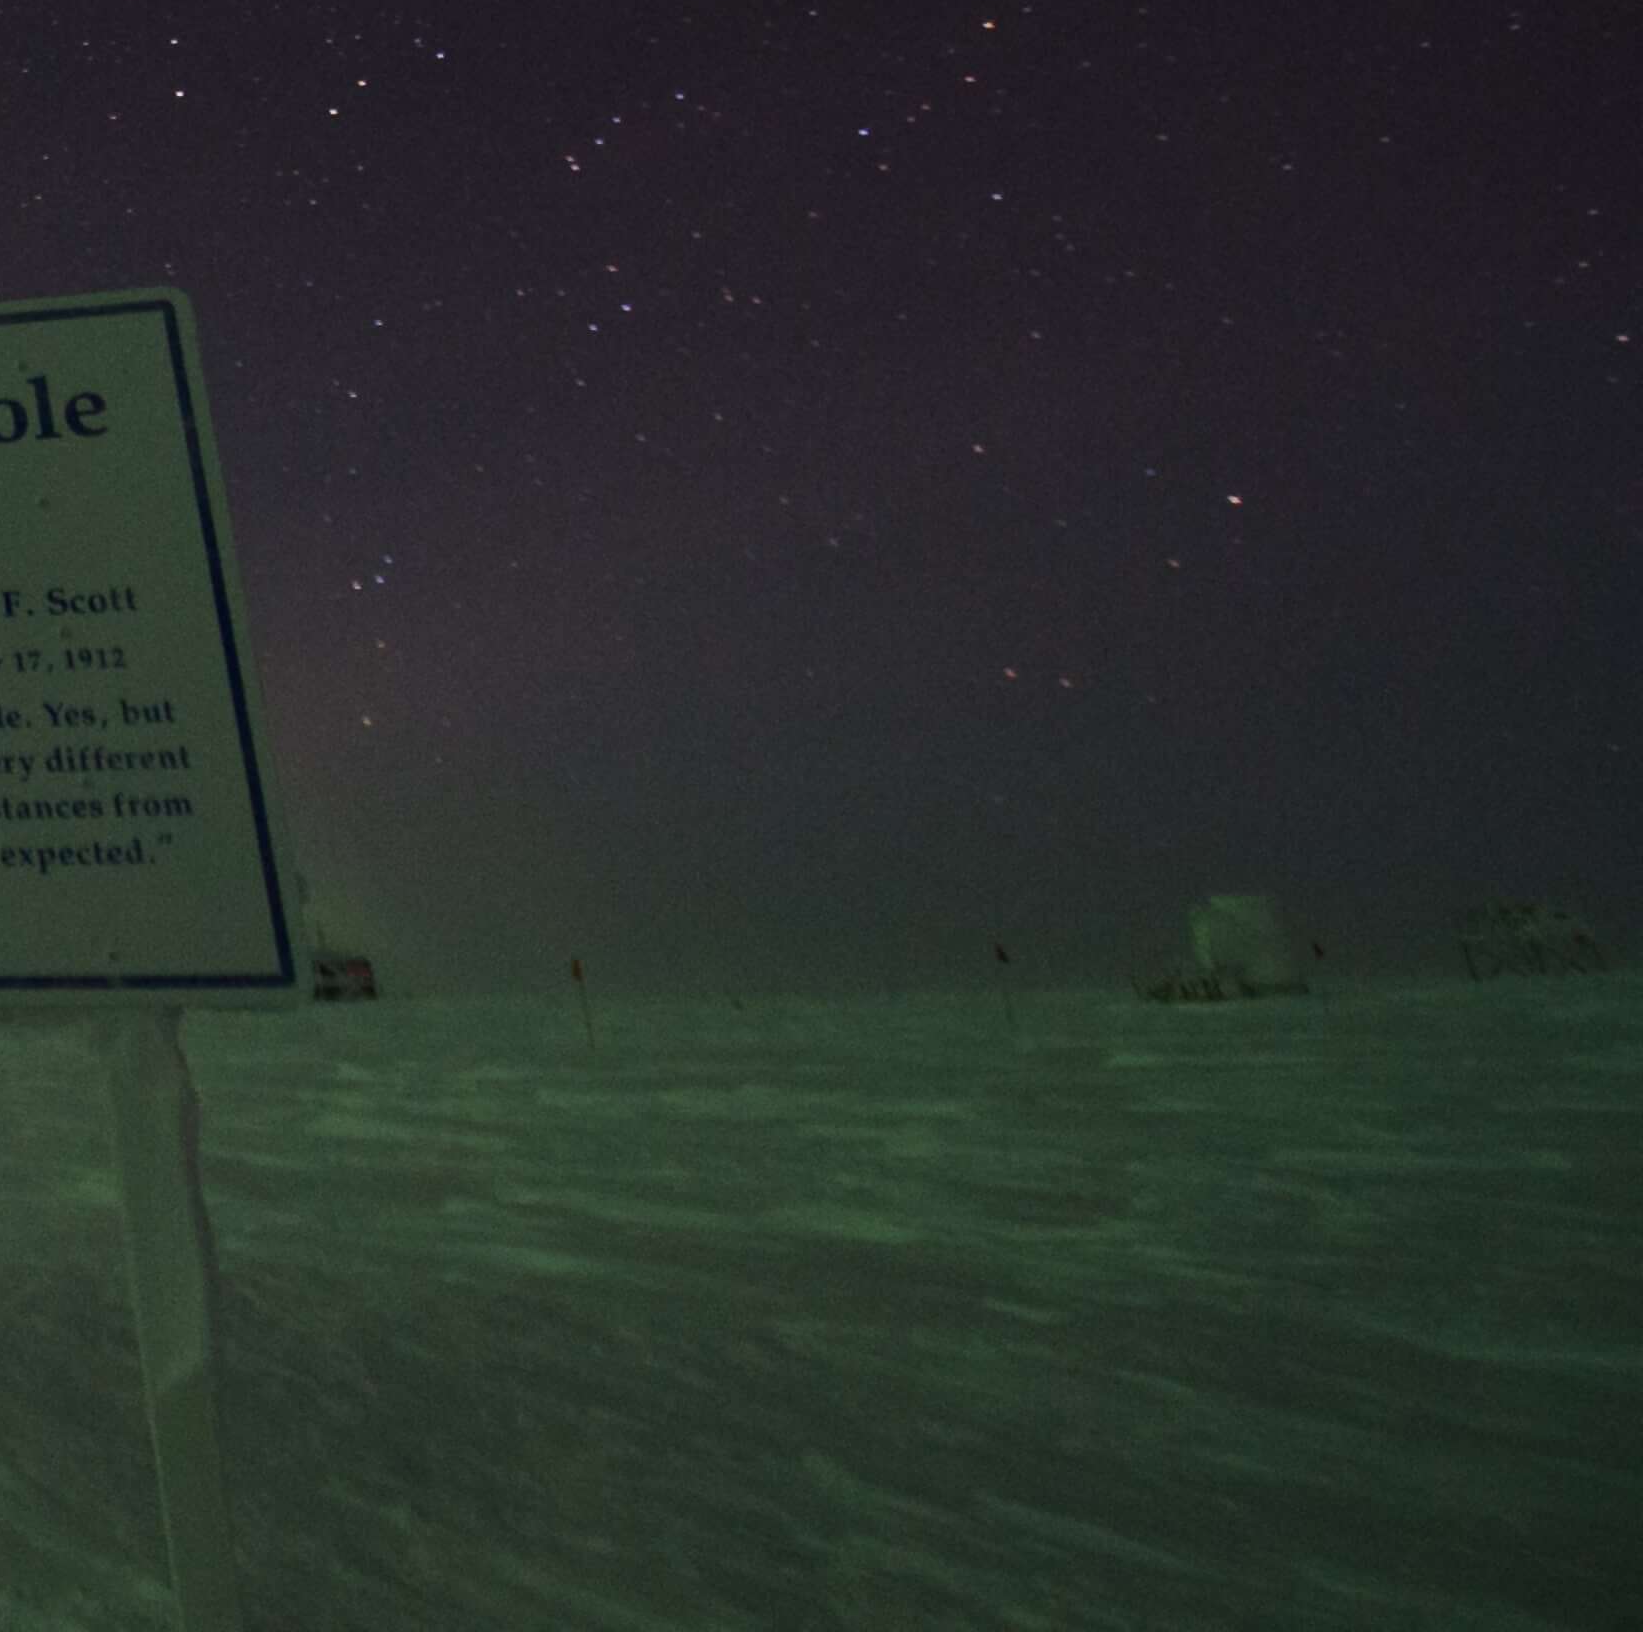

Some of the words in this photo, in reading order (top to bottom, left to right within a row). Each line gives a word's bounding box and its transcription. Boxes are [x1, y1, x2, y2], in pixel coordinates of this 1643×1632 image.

[2, 591, 34, 618] F.
[46, 586, 138, 616] Scott
[63, 647, 127, 672] 1912
[43, 701, 108, 730] Yes,
[119, 698, 176, 726] but
[45, 744, 191, 774] different
[113, 791, 193, 818] from
[0, 833, 173, 874] expected."
